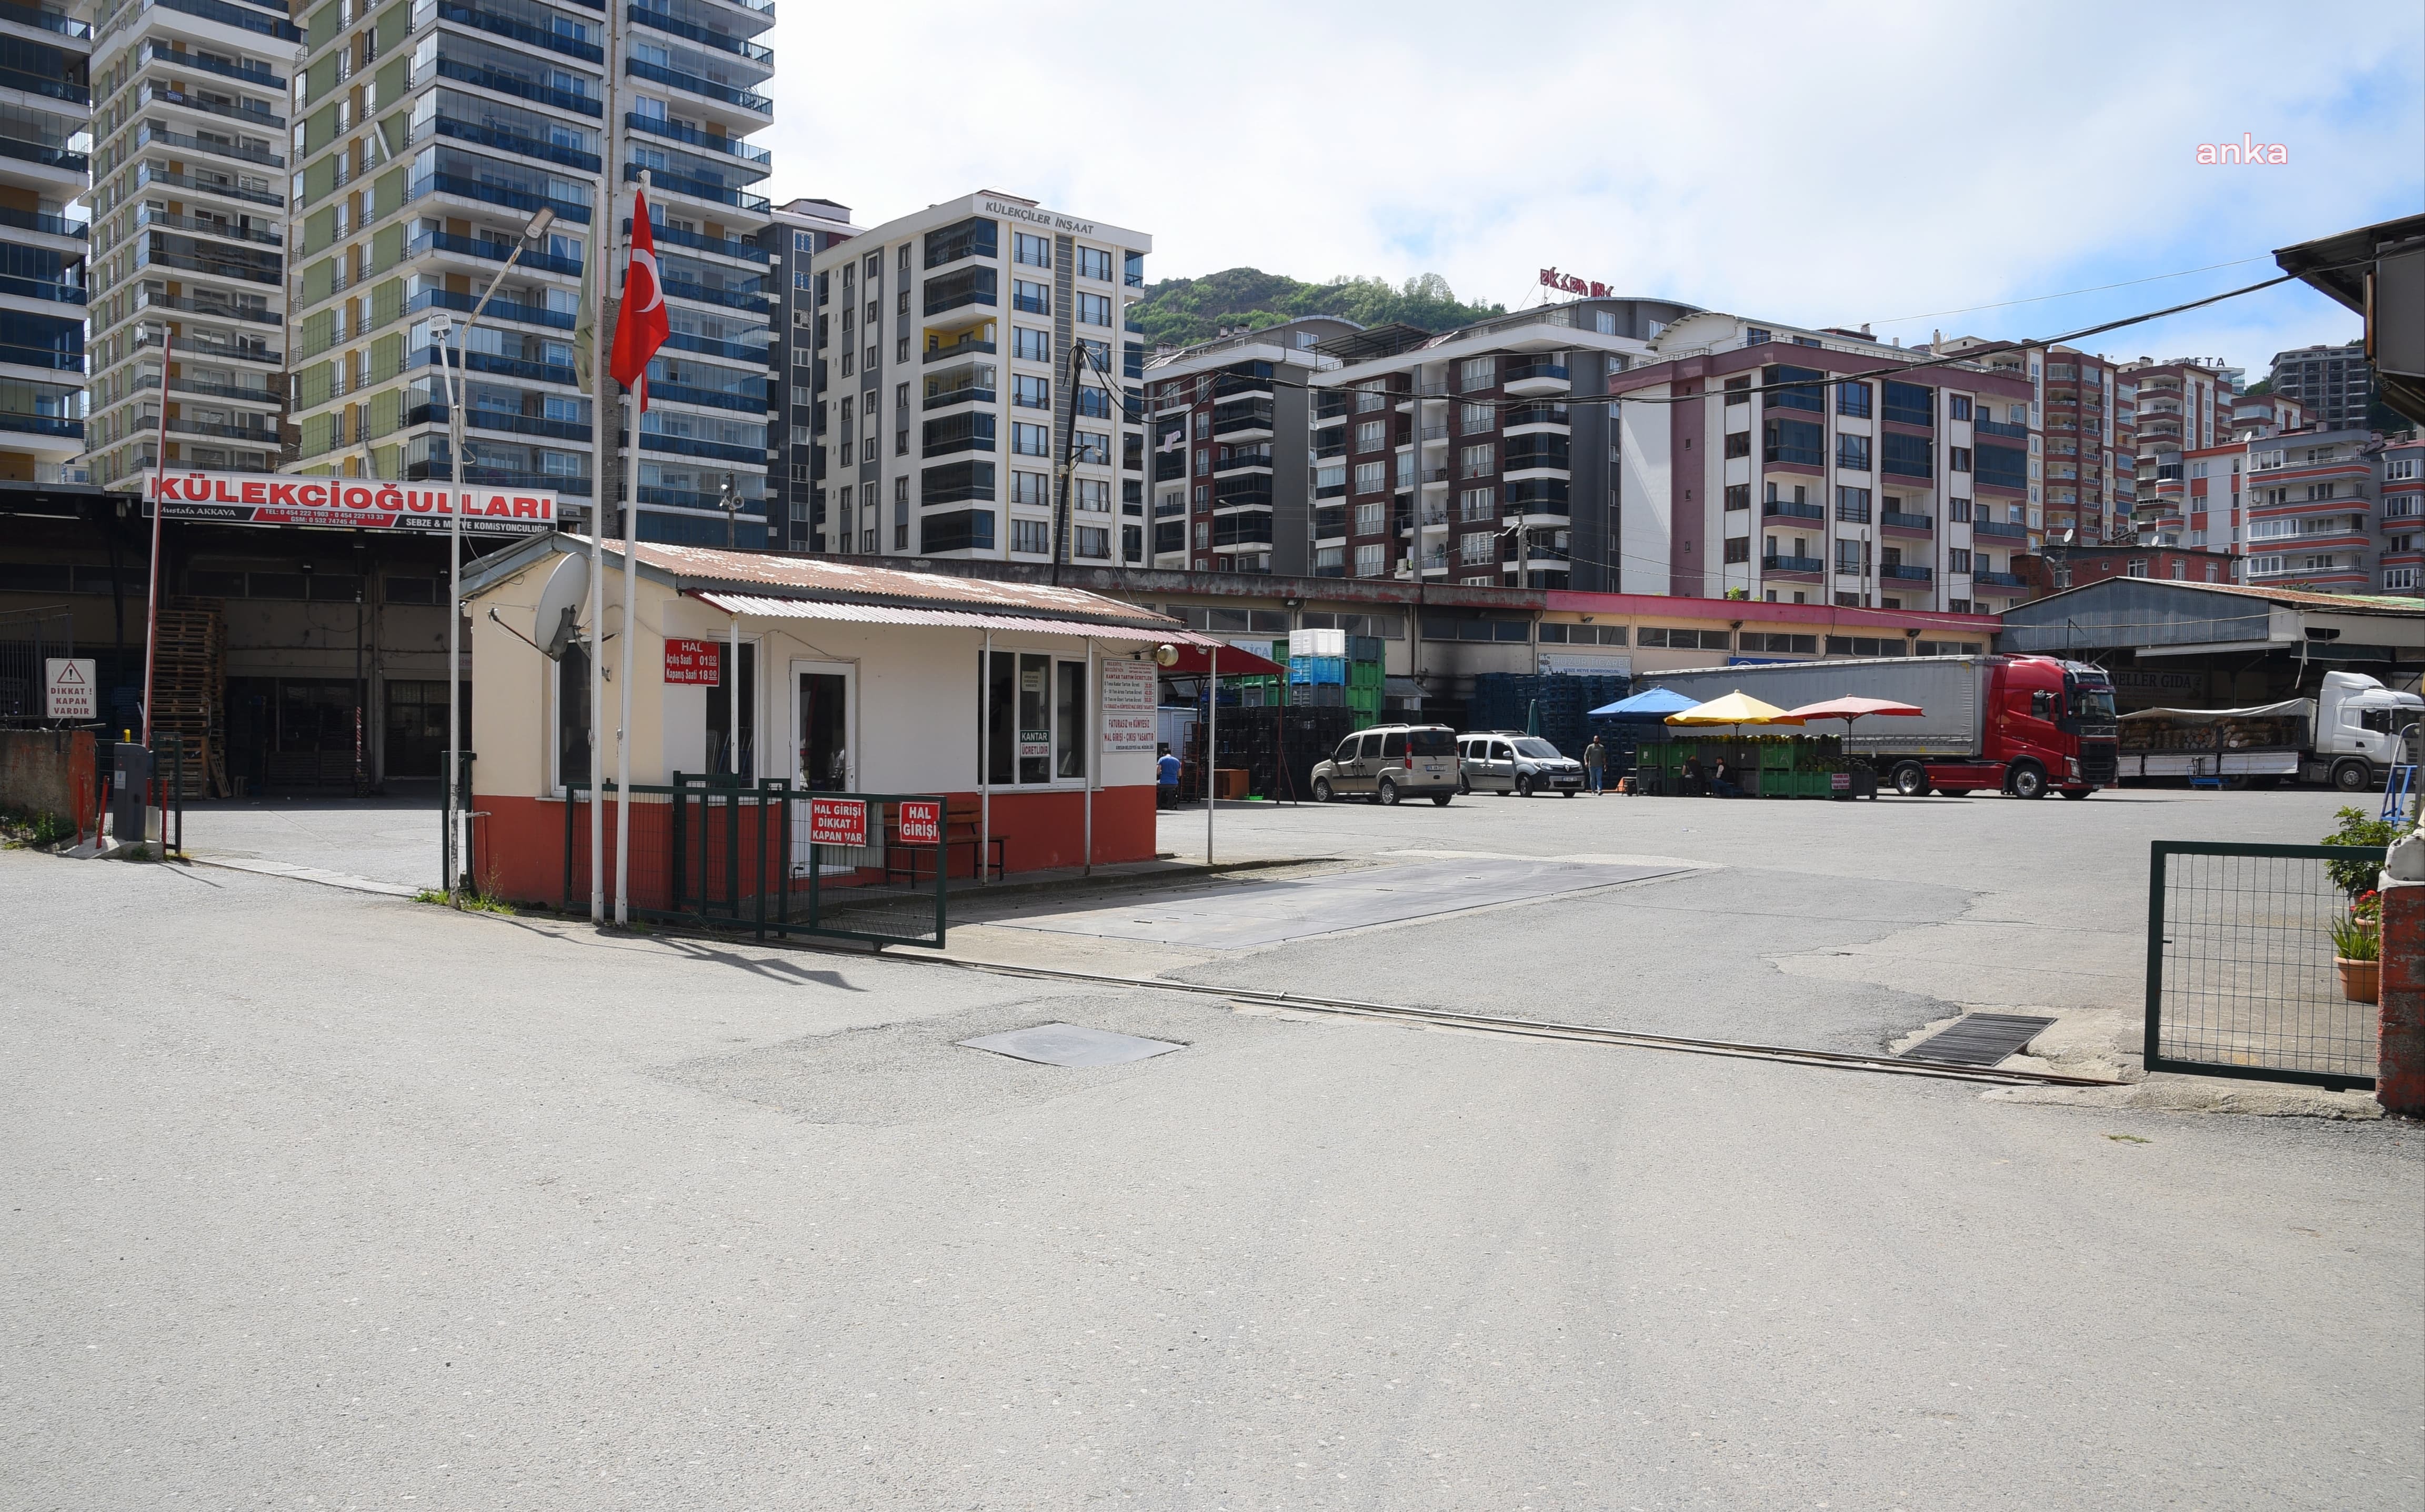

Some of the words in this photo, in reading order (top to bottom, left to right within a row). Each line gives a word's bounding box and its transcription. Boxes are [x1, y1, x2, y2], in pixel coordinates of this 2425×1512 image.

[986, 202, 1050, 225] KÜLEKÇİLER
[1055, 217, 1094, 235] İNŞAAT
[406, 518, 431, 526] SEBZE
[443, 520, 472, 529] MVE
[682, 642, 703, 652] HAL
[666, 653, 679, 667] Açılış
[680, 654, 692, 665] Saati
[1553, 658, 1587, 666] HUZUR
[666, 668, 684, 682] Kapanış
[686, 669, 697, 680] Saati
[51, 686, 85, 695] DİKKAT
[1109, 719, 1128, 728] FATURASIZ
[1133, 717, 1149, 728] KÜNYESİZ
[1021, 732, 1047, 741] KANTAR
[1113, 730, 1124, 743] GİRİŞİ
[1126, 732, 1137, 743] ÇIKIŞI
[1137, 732, 1154, 741] YASAKTIR
[1022, 744, 1048, 755] ÜCRETLİDİR
[815, 805, 831, 814] HAL
[834, 803, 861, 818] GİRİŞİ
[909, 807, 931, 819] HAL
[818, 815, 850, 829] DİKKAT
[903, 820, 937, 839] GİRİŞİ
[813, 830, 841, 842] KAPAN
[845, 833, 863, 842] VAR
